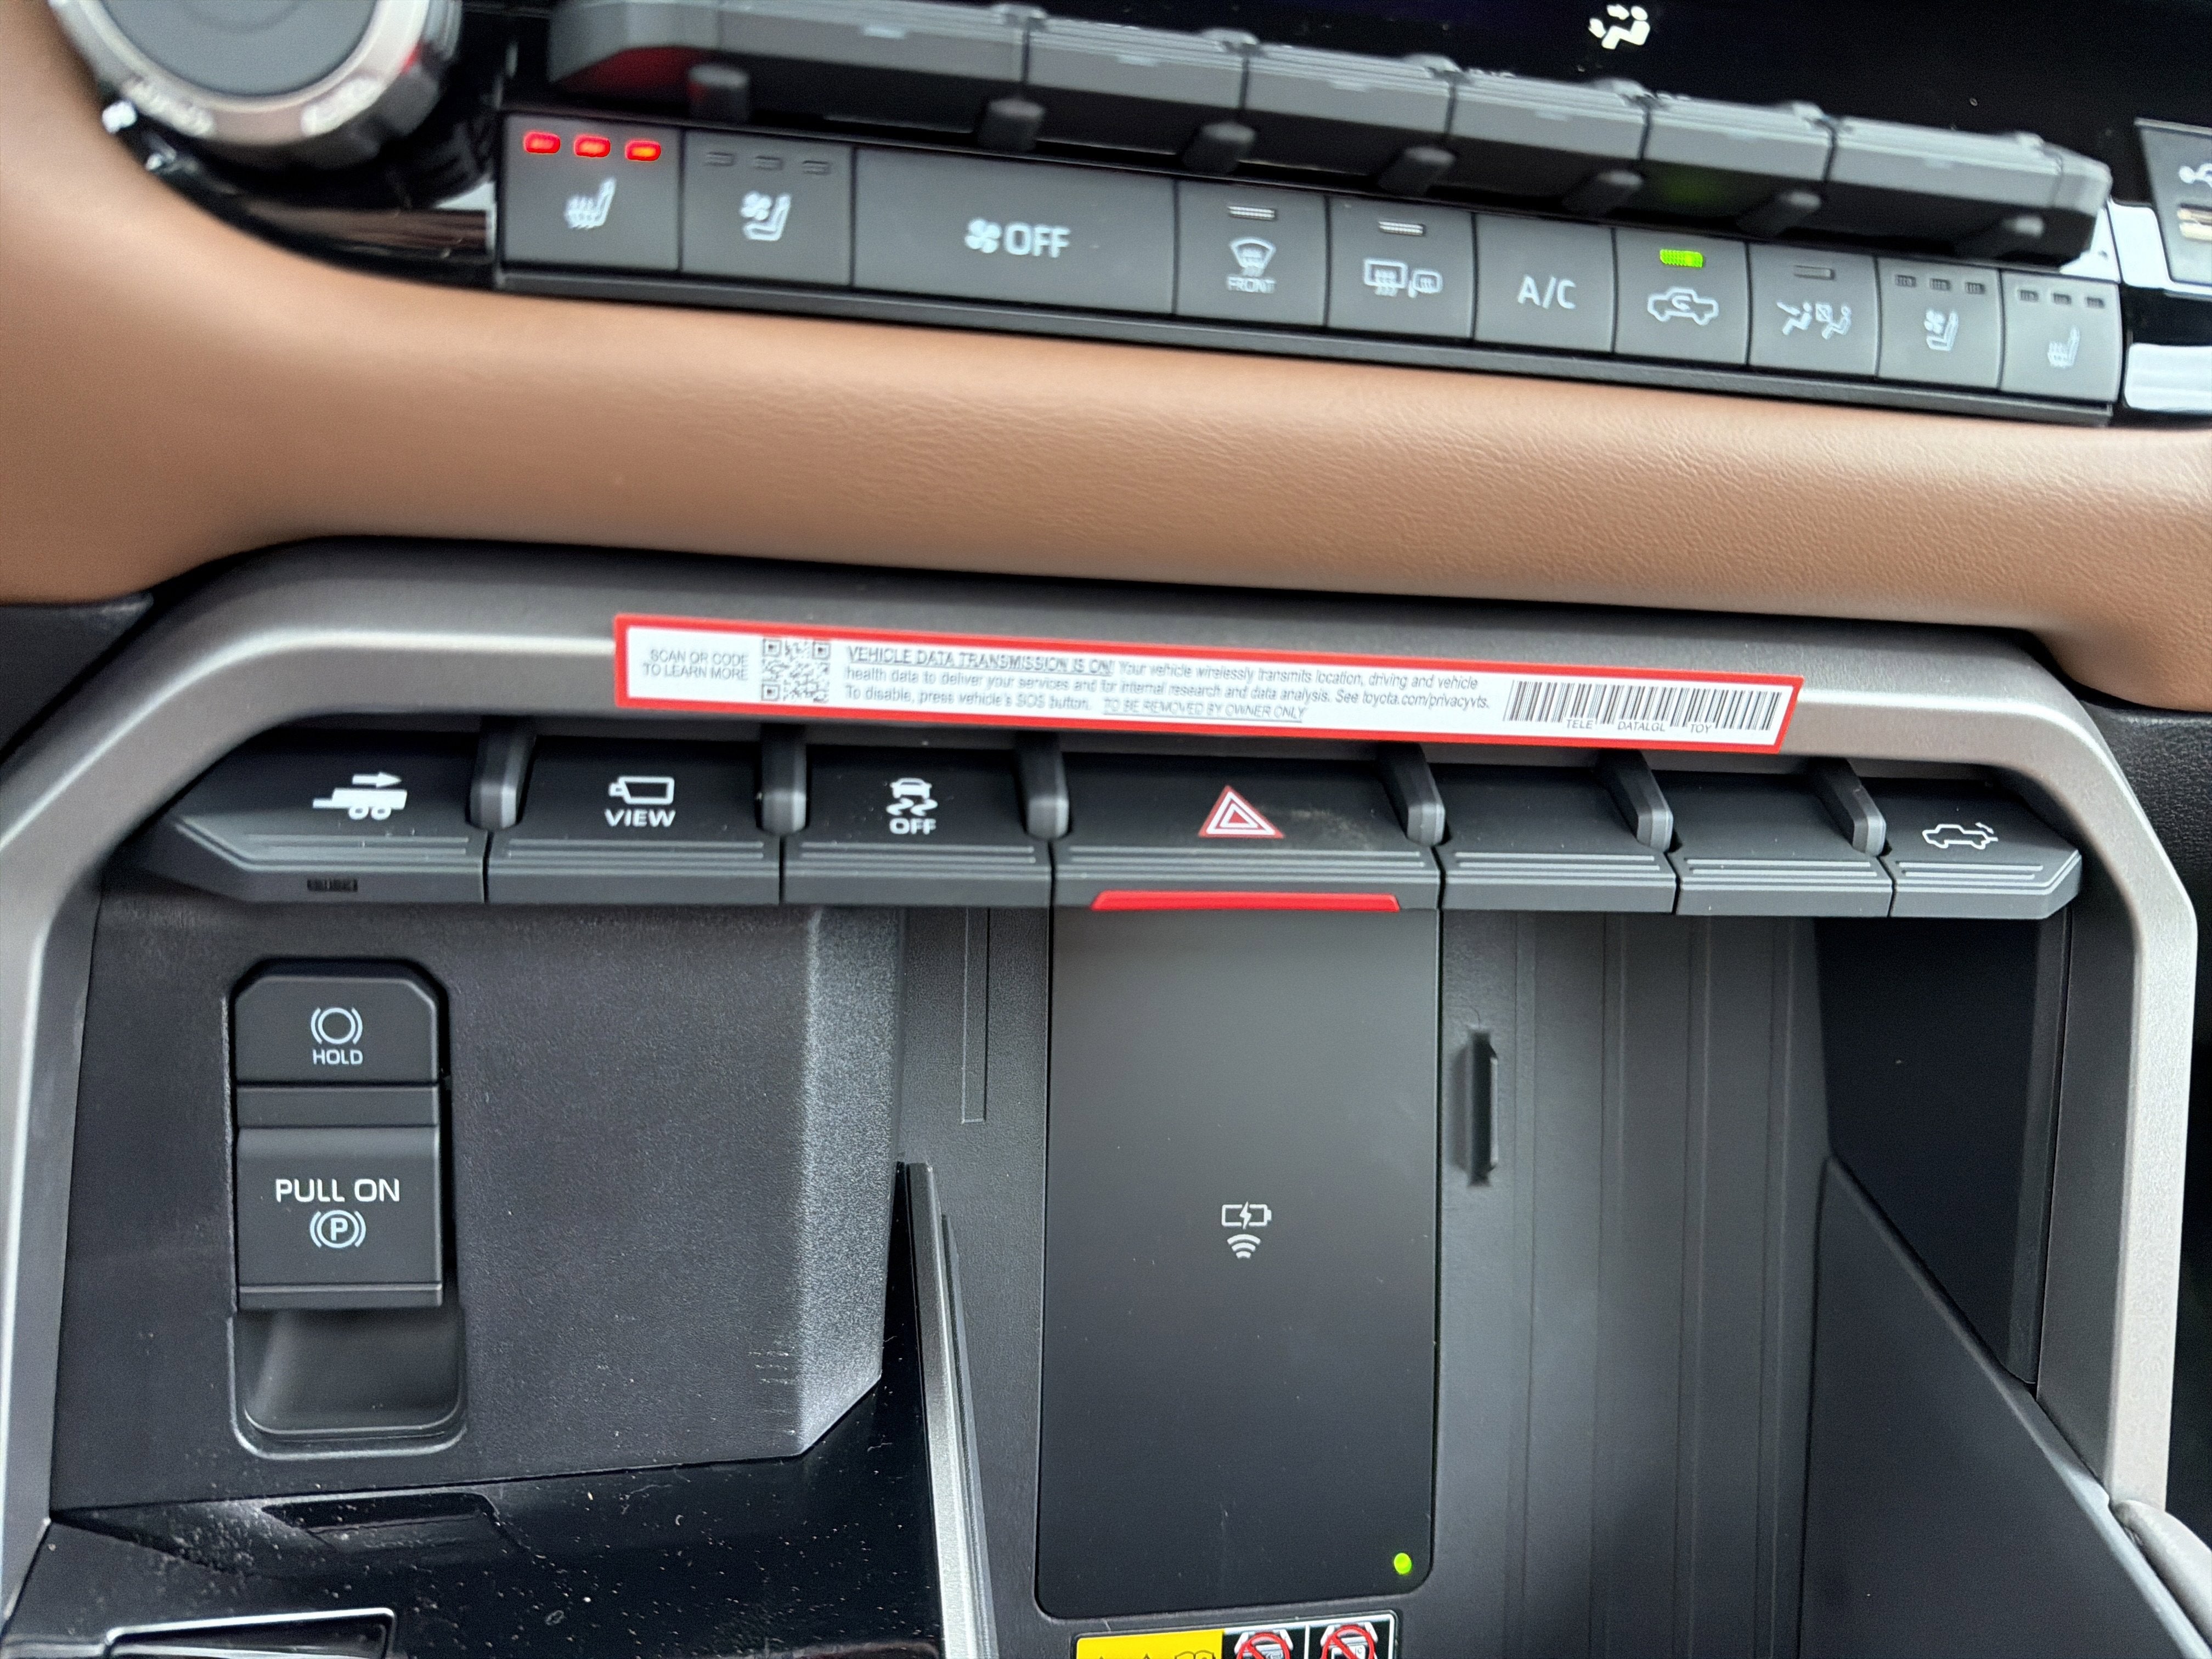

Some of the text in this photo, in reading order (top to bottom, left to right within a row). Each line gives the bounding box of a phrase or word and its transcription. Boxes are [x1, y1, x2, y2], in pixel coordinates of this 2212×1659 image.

[1004, 223, 1071, 258] OFF
[1227, 275, 1277, 294] FRONT
[1517, 275, 1577, 309] A/C
[650, 648, 686, 663] SCAN
[713, 653, 748, 667] CODE
[643, 663, 748, 681] TO LEARN MORE
[848, 646, 913, 664] VEHICLE
[916, 650, 956, 667] DATA
[959, 652, 1068, 672] TRANSMISSION
[1073, 658, 1085, 673] IS
[1118, 661, 1146, 675] Your
[1150, 663, 1192, 678] vehicle
[1196, 664, 1254, 683] wirelessly
[1259, 668, 1312, 684] transmits
[1316, 670, 1364, 686] location,
[1369, 672, 1407, 690] driving
[1412, 674, 1435, 689] and
[1438, 675, 1478, 690] vehicle
[845, 667, 887, 682] health
[891, 670, 919, 683] data
[924, 671, 936, 684] to
[941, 672, 983, 686] deliver
[987, 677, 1014, 691] your
[1017, 677, 1069, 691] services
[1074, 679, 1097, 692] and
[1100, 679, 1117, 692] for
[1121, 681, 1167, 695] internal
[1169, 683, 1223, 698] research
[1225, 685, 1248, 699] and
[1250, 686, 1277, 700] data
[1280, 689, 1330, 704] analysis.
[1335, 689, 1359, 704] See
[845, 685, 1307, 720] To disable, press vehicle's SOS button. TO BE REMOVED BY OWNER ONLY
[1566, 719, 1594, 730] TELE
[1690, 723, 1713, 734] TOY
[605, 809, 676, 827] VIEW
[889, 817, 936, 835] OFF
[313, 1049, 363, 1065] HOLD
[276, 1178, 400, 1203] PULL ON
